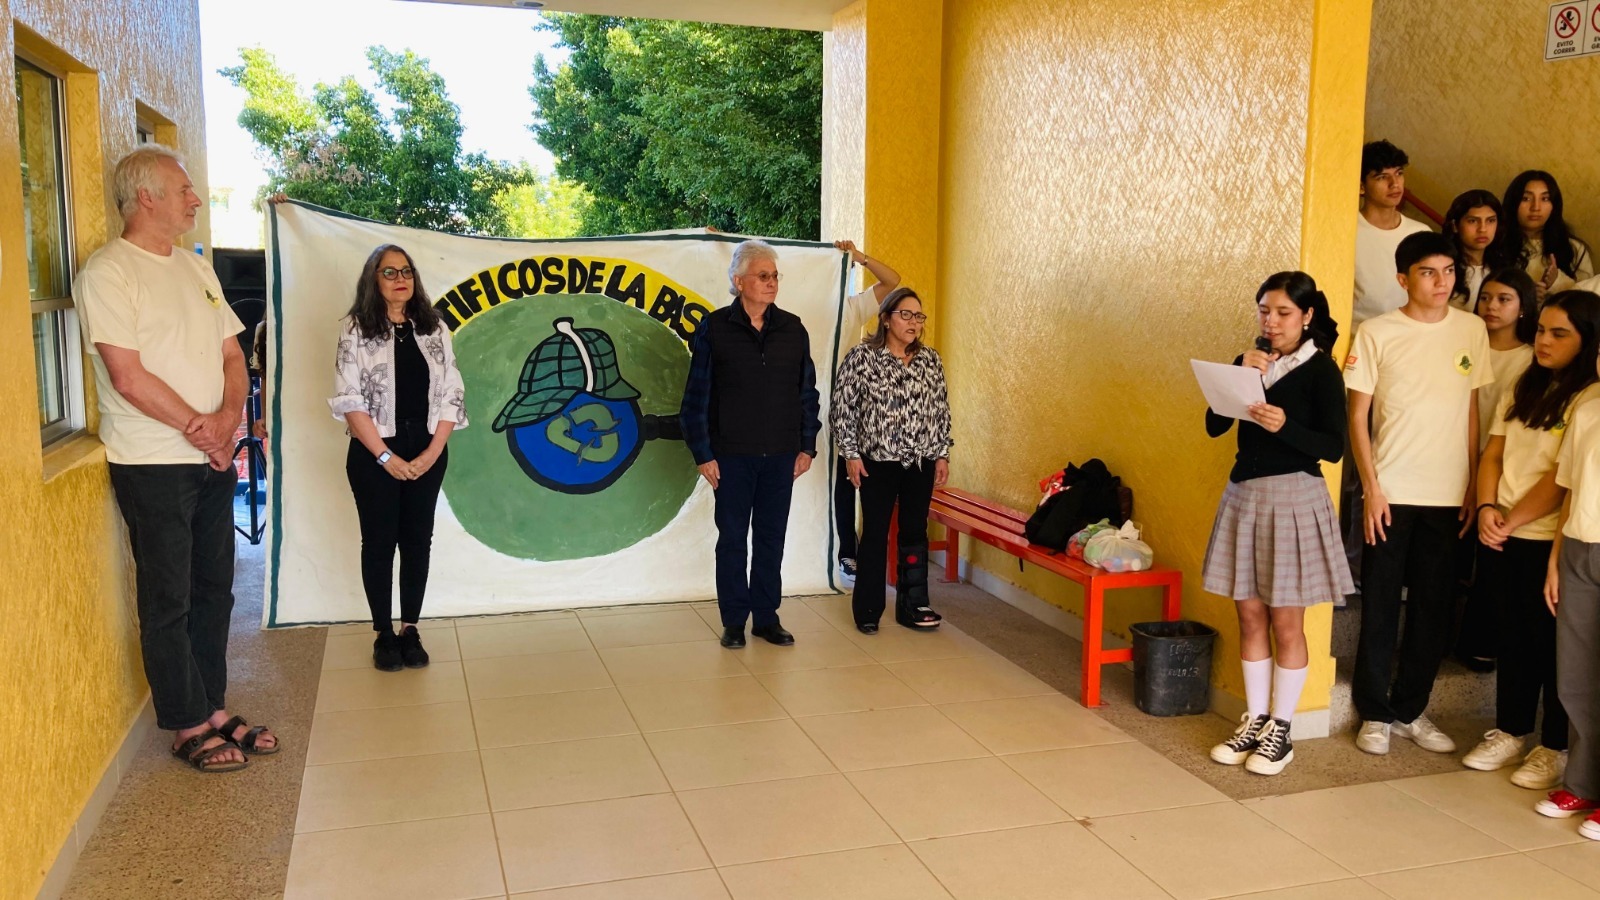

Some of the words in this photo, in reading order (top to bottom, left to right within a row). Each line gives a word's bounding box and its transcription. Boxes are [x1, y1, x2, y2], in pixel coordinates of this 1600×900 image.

[1554, 46, 1576, 54] CORRER
[604, 265, 646, 309] LA
[648, 285, 711, 353] BAS
